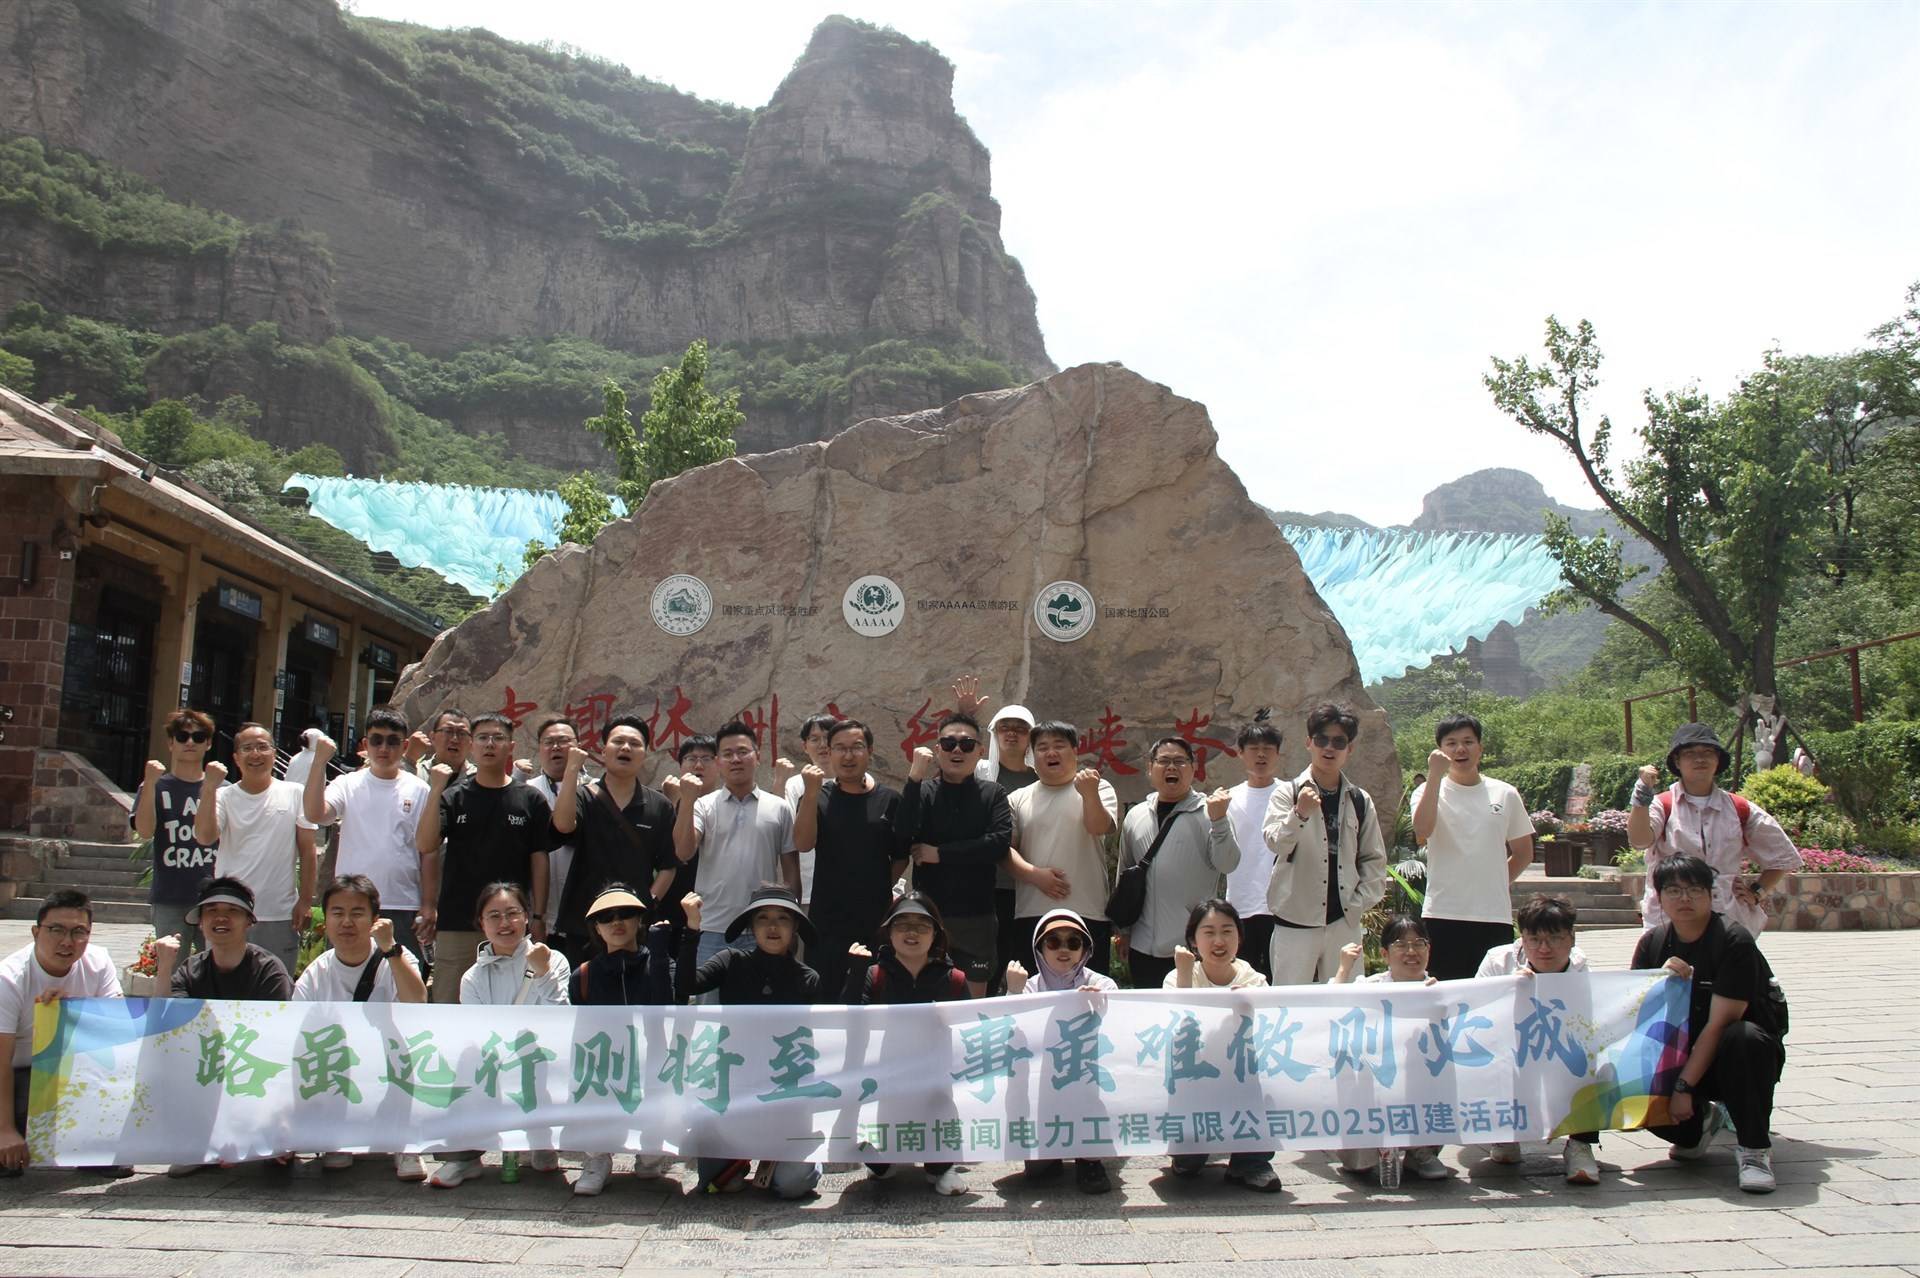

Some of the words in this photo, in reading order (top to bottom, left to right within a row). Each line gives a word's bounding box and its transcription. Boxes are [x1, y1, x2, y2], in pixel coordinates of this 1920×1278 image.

[852, 617, 895, 628] AAAAA
[162, 791, 172, 809] I
[183, 796, 201, 816] A
